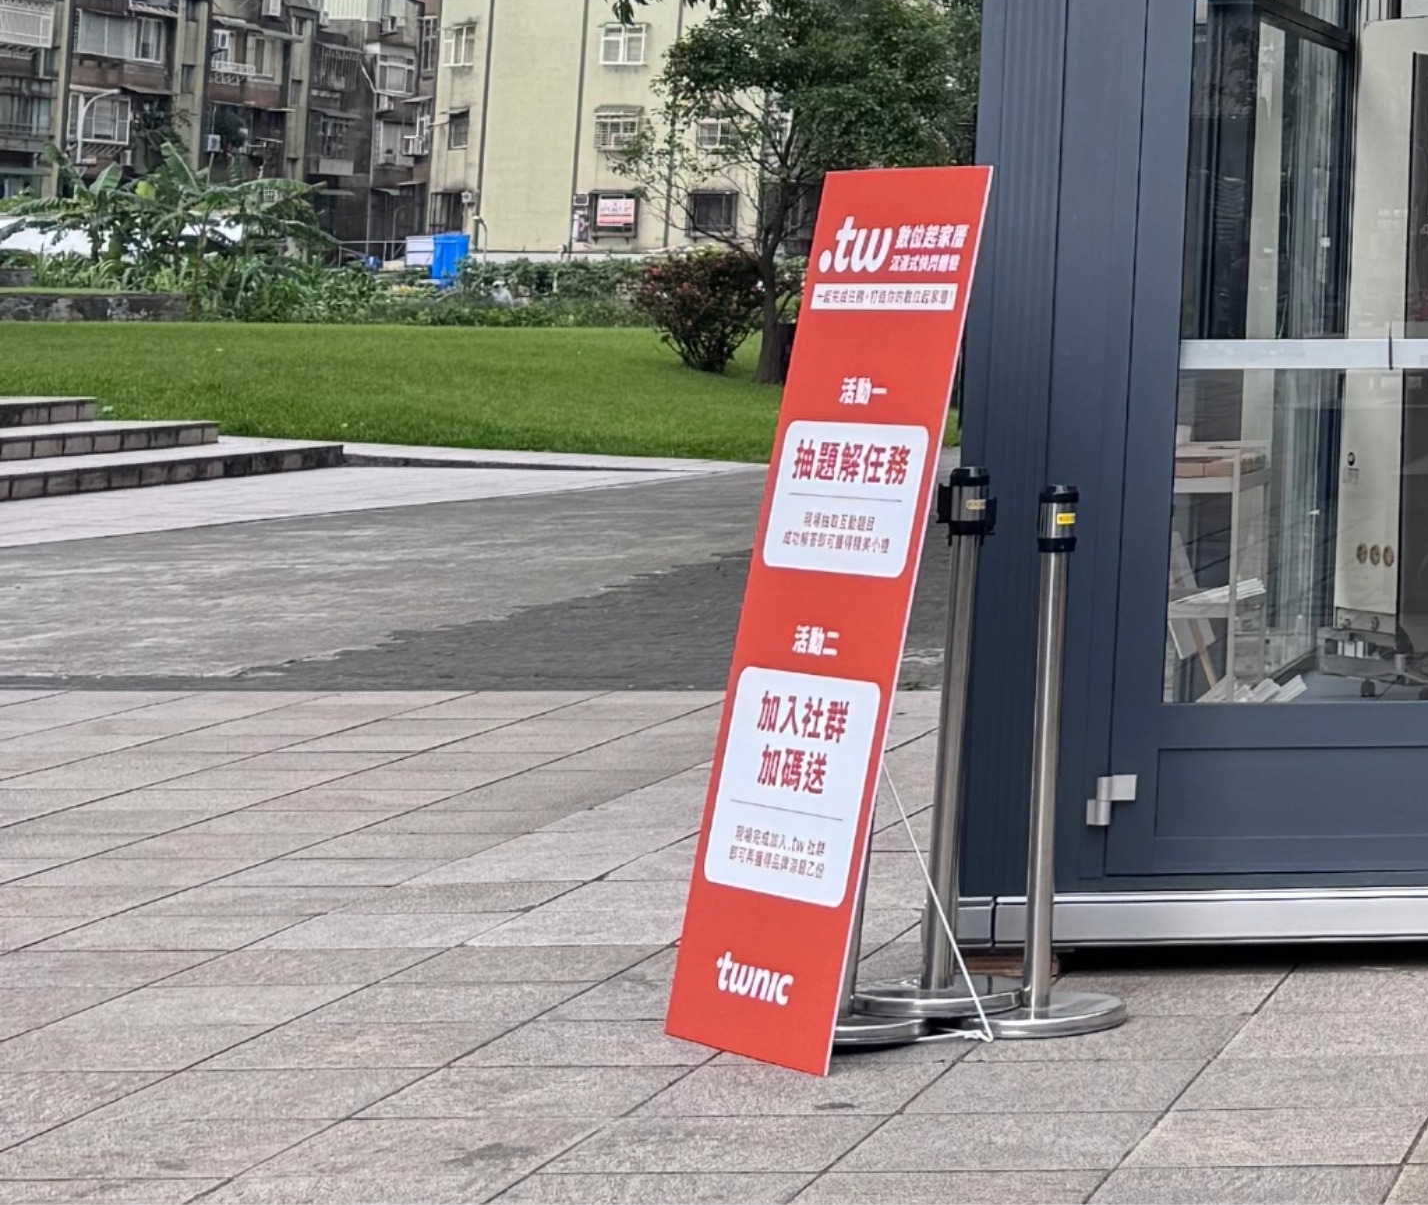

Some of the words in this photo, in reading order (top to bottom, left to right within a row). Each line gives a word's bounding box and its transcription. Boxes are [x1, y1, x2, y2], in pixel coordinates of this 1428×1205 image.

[818, 215, 894, 273] .tw
[895, 224, 970, 249] 數位起家厝
[839, 376, 888, 405] 活動一
[792, 438, 911, 486] 抽題解任務
[791, 624, 840, 657] 活動二
[756, 689, 850, 744] 加入社群
[757, 743, 828, 795] 加碼送
